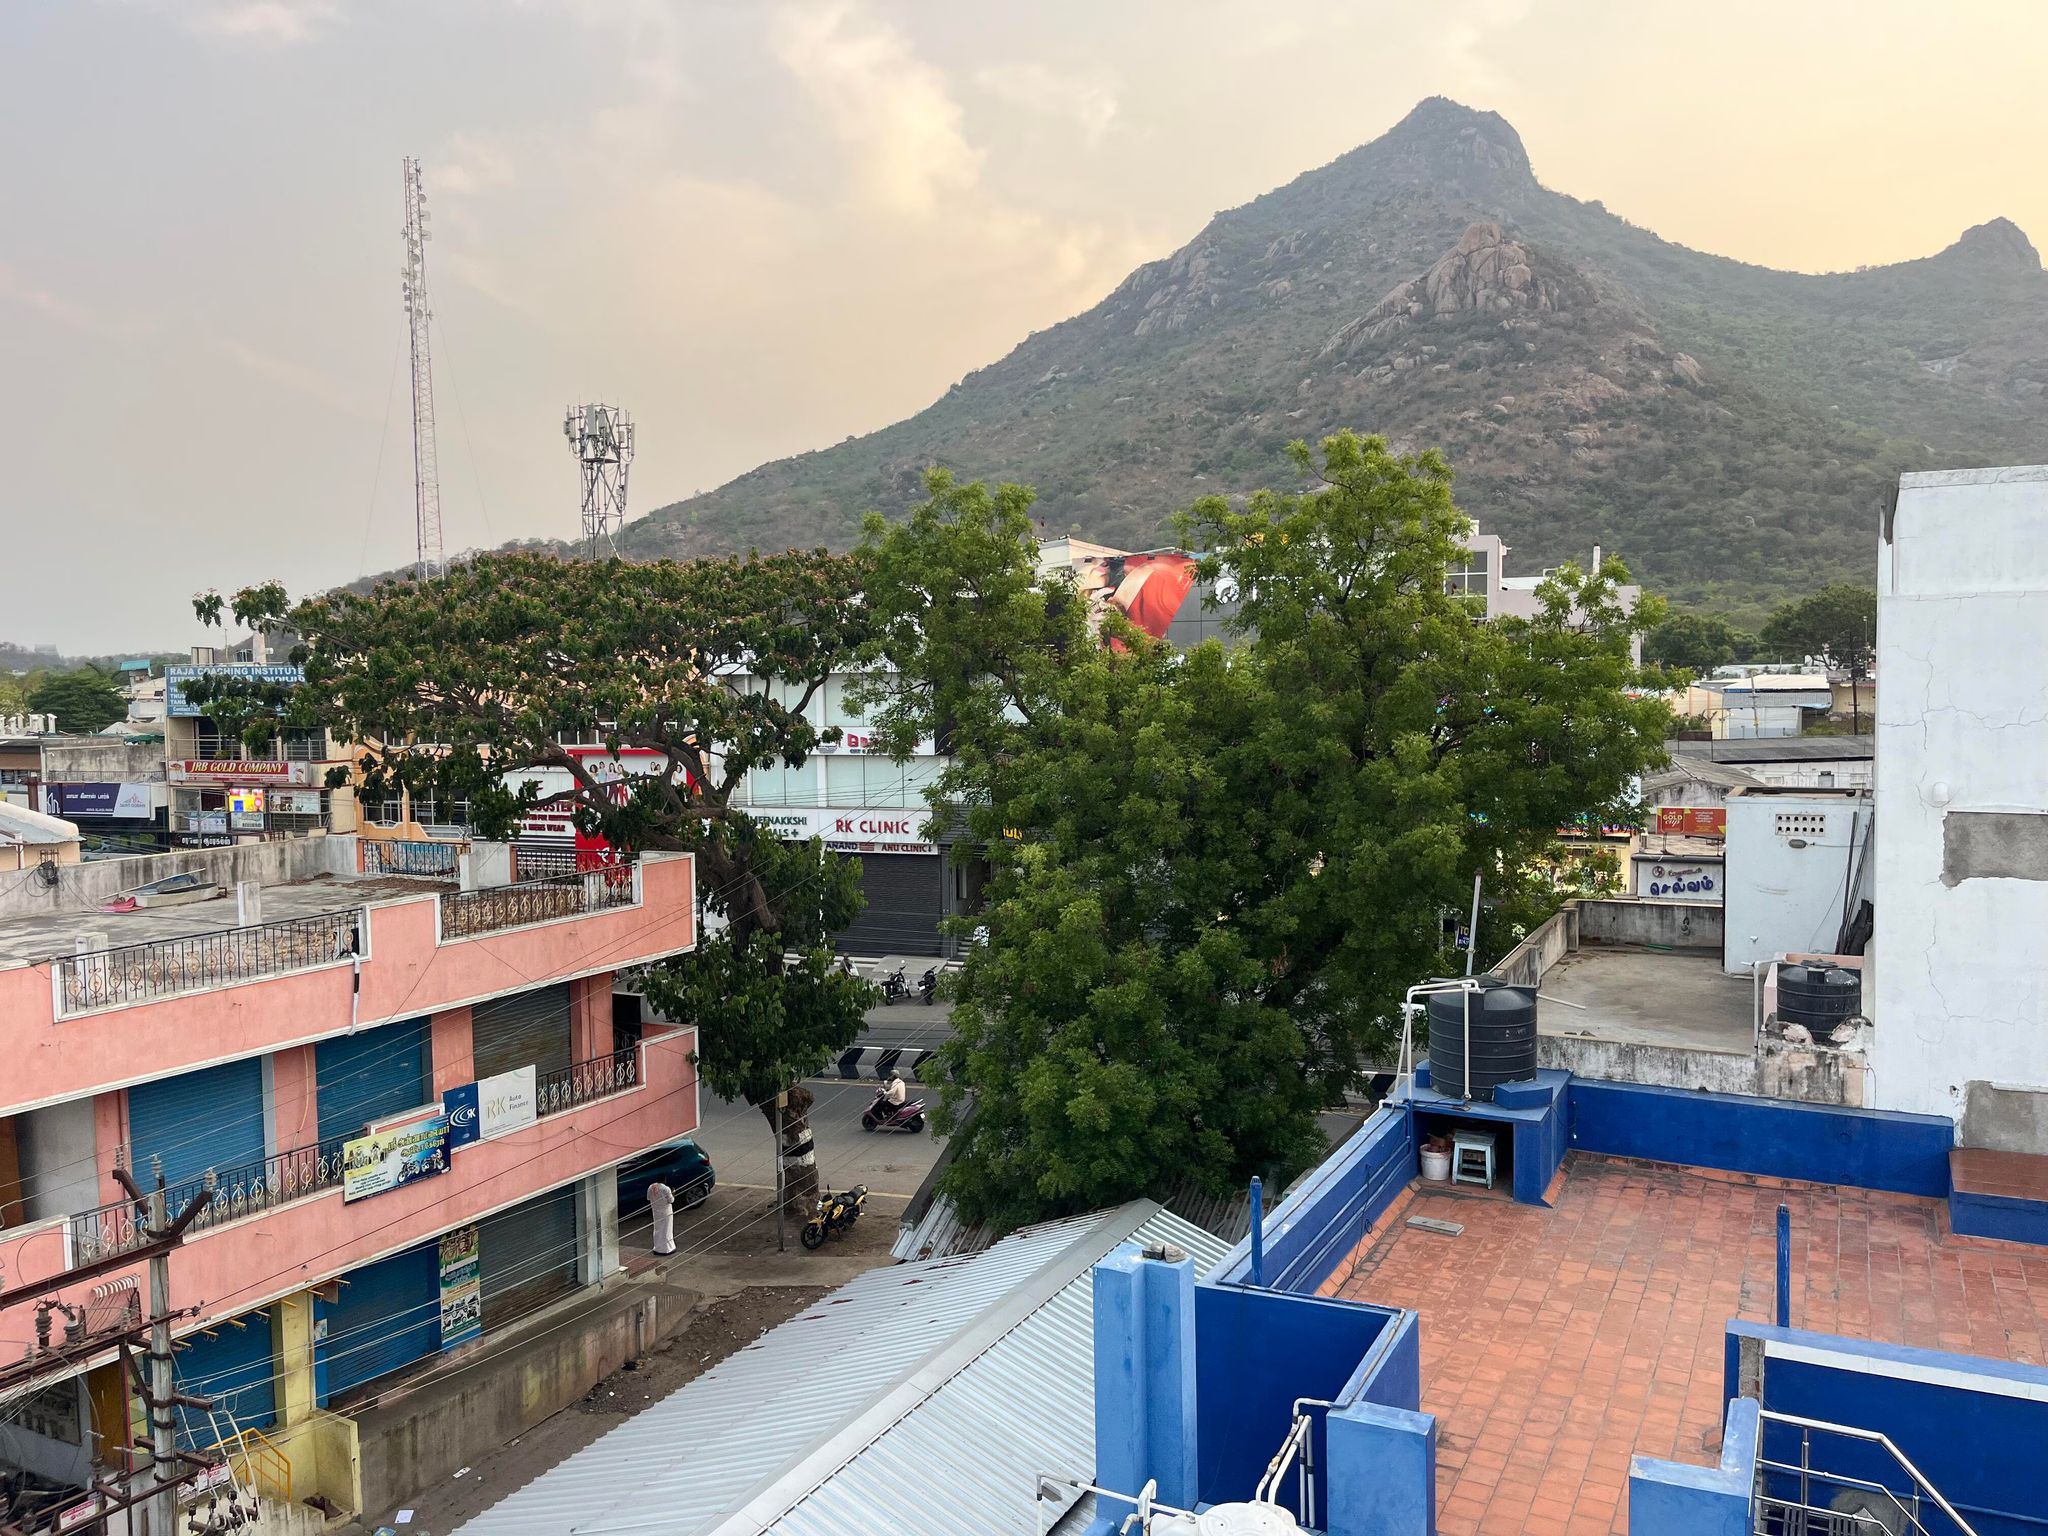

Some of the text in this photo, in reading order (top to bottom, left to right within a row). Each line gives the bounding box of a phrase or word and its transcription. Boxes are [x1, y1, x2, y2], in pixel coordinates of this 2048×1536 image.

[170, 667, 305, 676] RAJA COACHING INSTITUTE
[191, 761, 284, 773] JRB GOLD COMPANY
[836, 819, 854, 833] RK
[859, 821, 910, 834] CLINIC
[901, 843, 928, 852] CLINIC
[1650, 876, 1713, 896] செல்வம்
